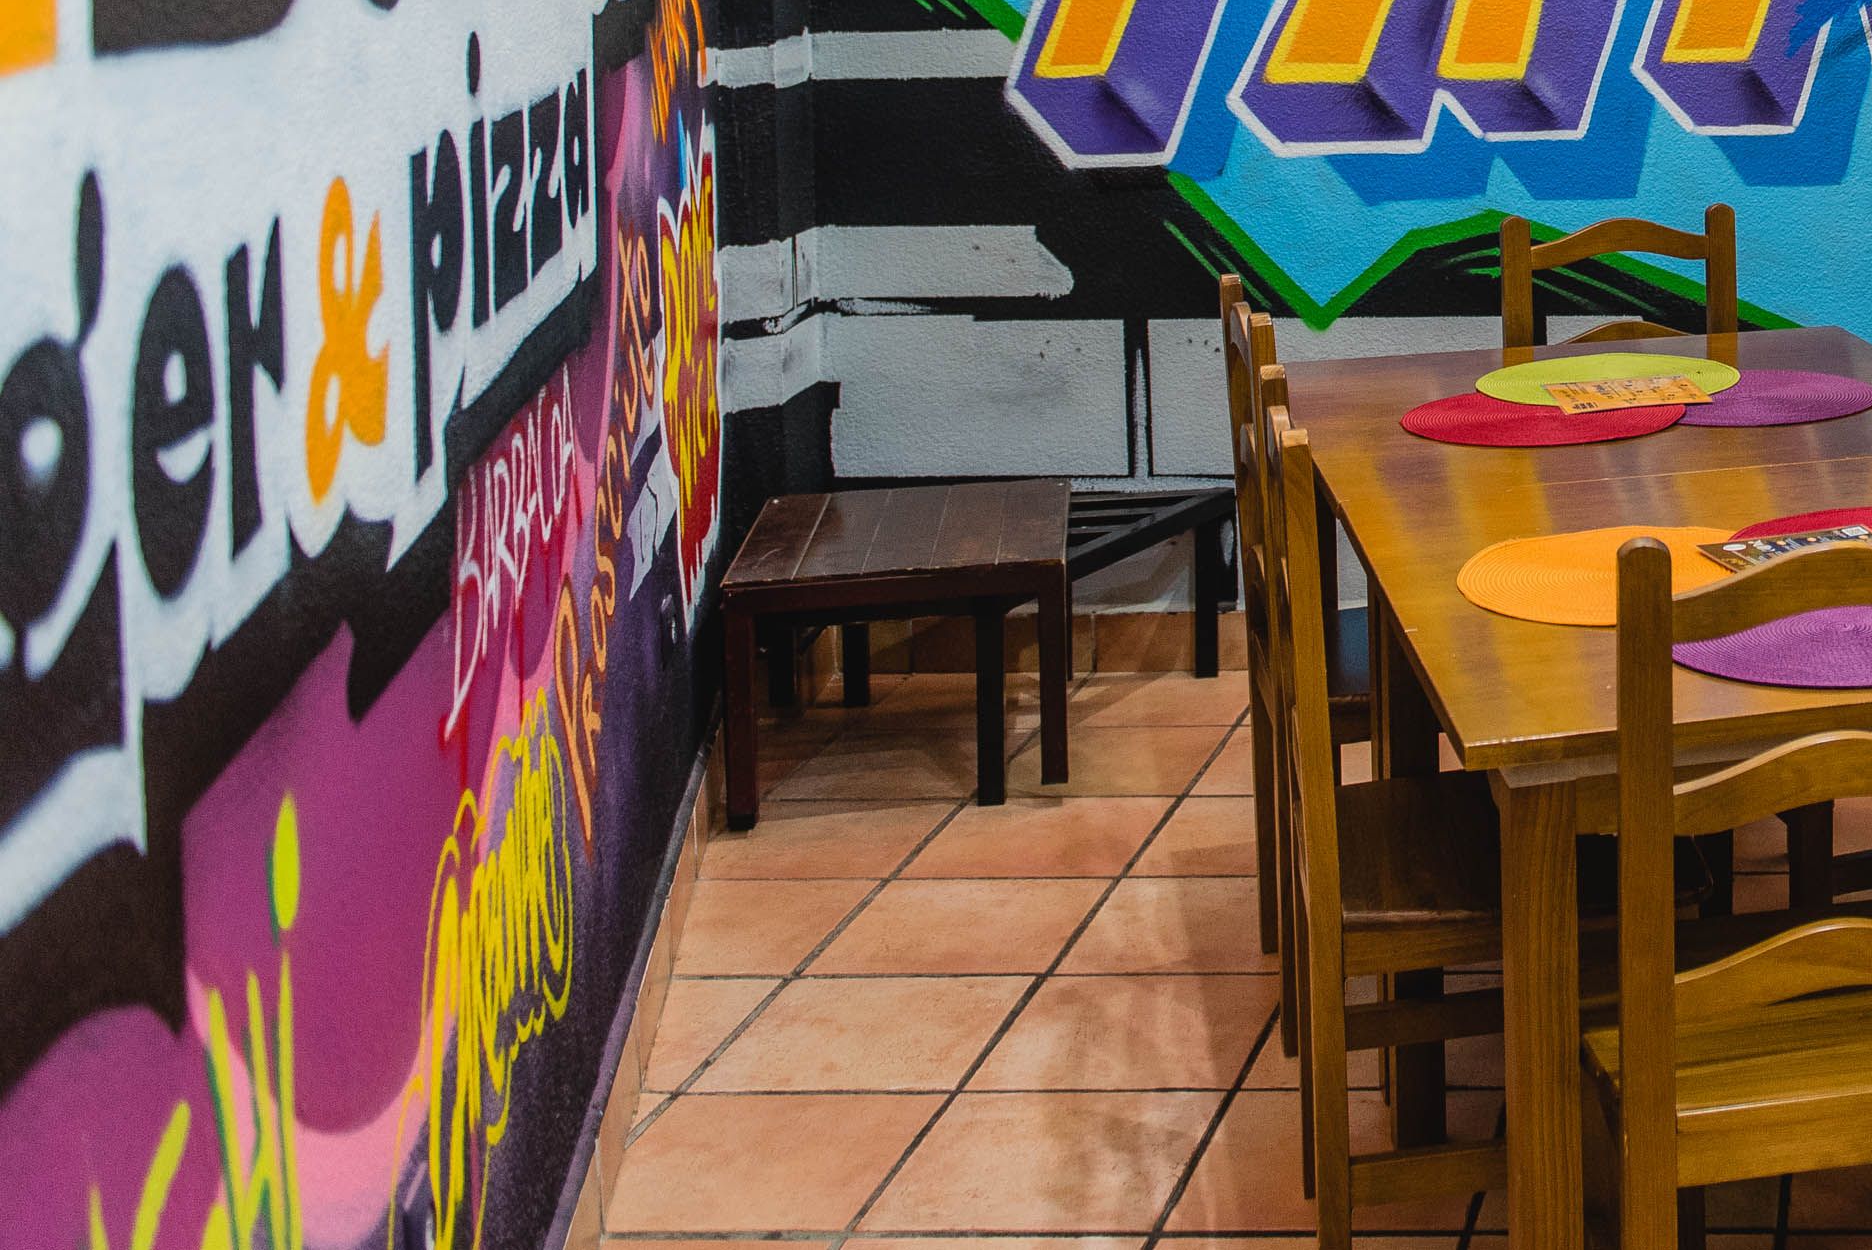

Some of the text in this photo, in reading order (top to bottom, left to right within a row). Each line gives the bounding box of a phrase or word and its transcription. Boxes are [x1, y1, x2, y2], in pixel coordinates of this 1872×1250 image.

[305, 174, 391, 507] &
[410, 30, 592, 484] pizza
[445, 361, 578, 741] BARBACOA
